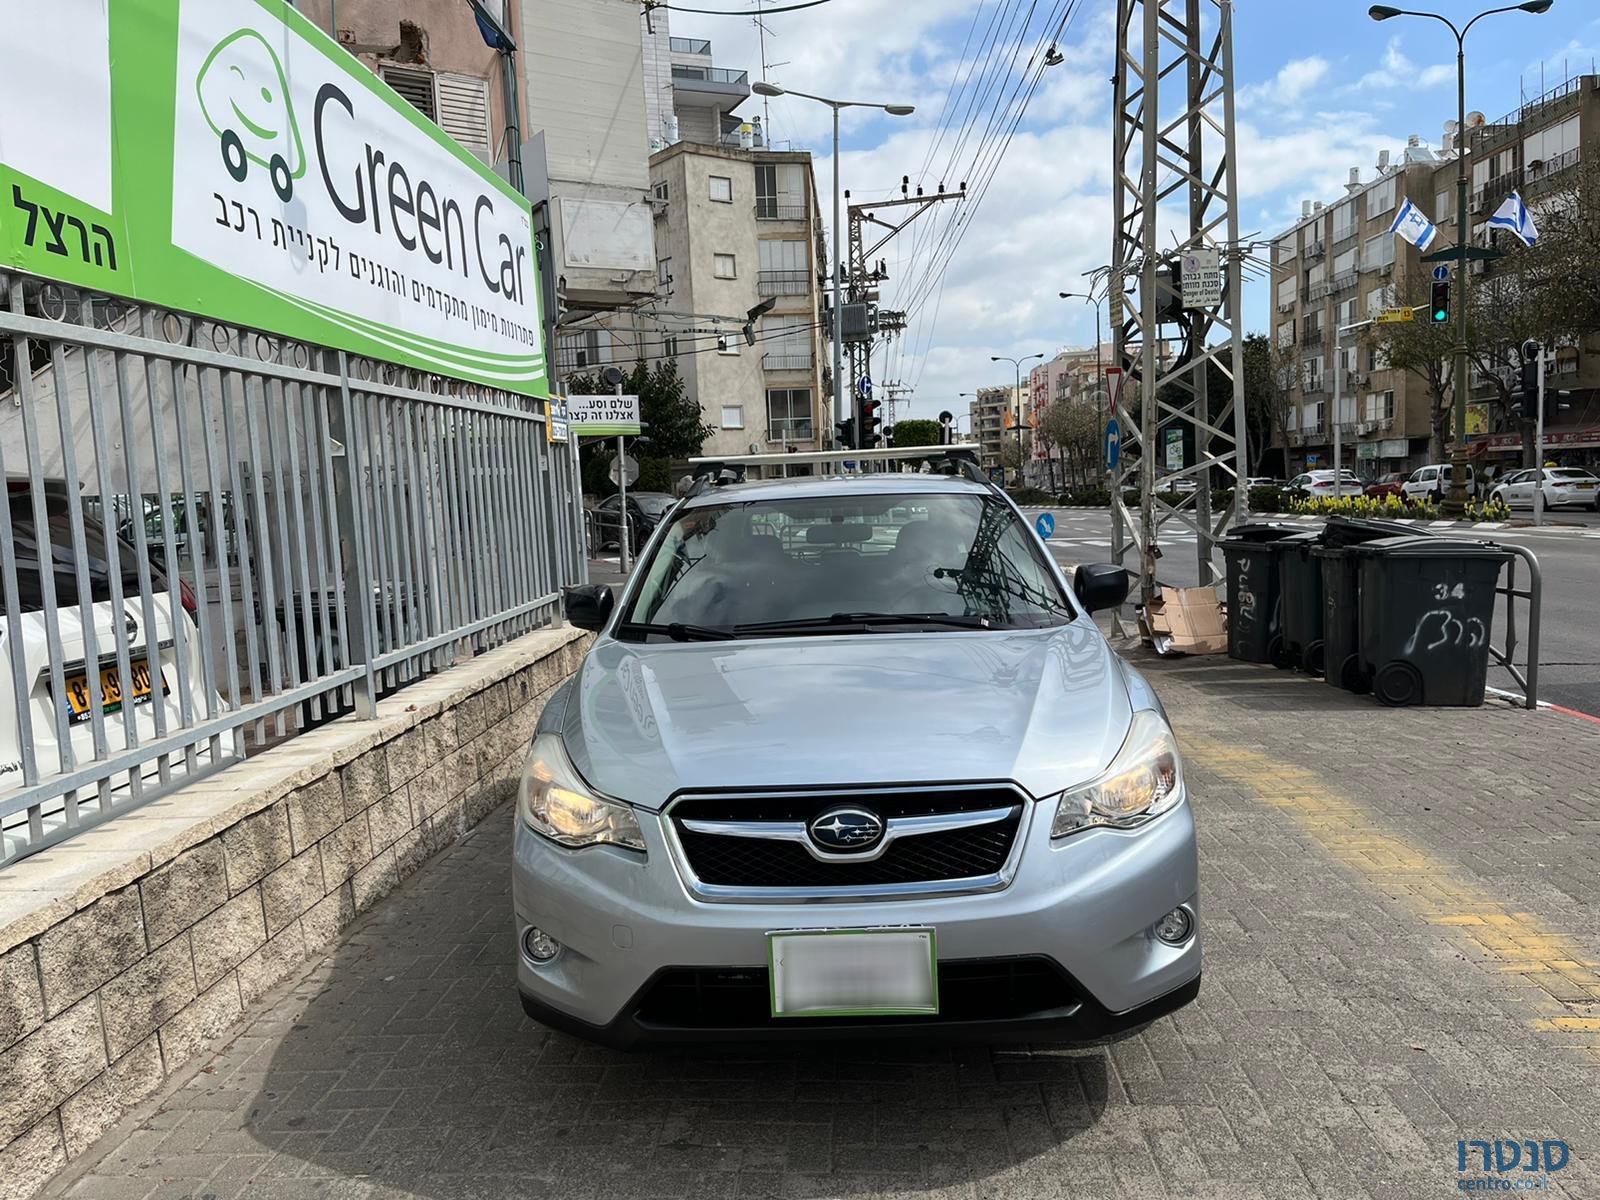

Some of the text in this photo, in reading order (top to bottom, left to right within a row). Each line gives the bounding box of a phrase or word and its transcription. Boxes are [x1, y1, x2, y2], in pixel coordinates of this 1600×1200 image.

[313, 82, 525, 305] Green Car
[12, 184, 117, 271] הרצל
[214, 192, 534, 347] פתרונות מימון מתקדמים והוגנים לקניית רכב
[610, 398, 632, 409] שלם
[591, 411, 603, 420] זה
[605, 410, 634, 420] אצלנו
[1434, 583, 1464, 600] 34
